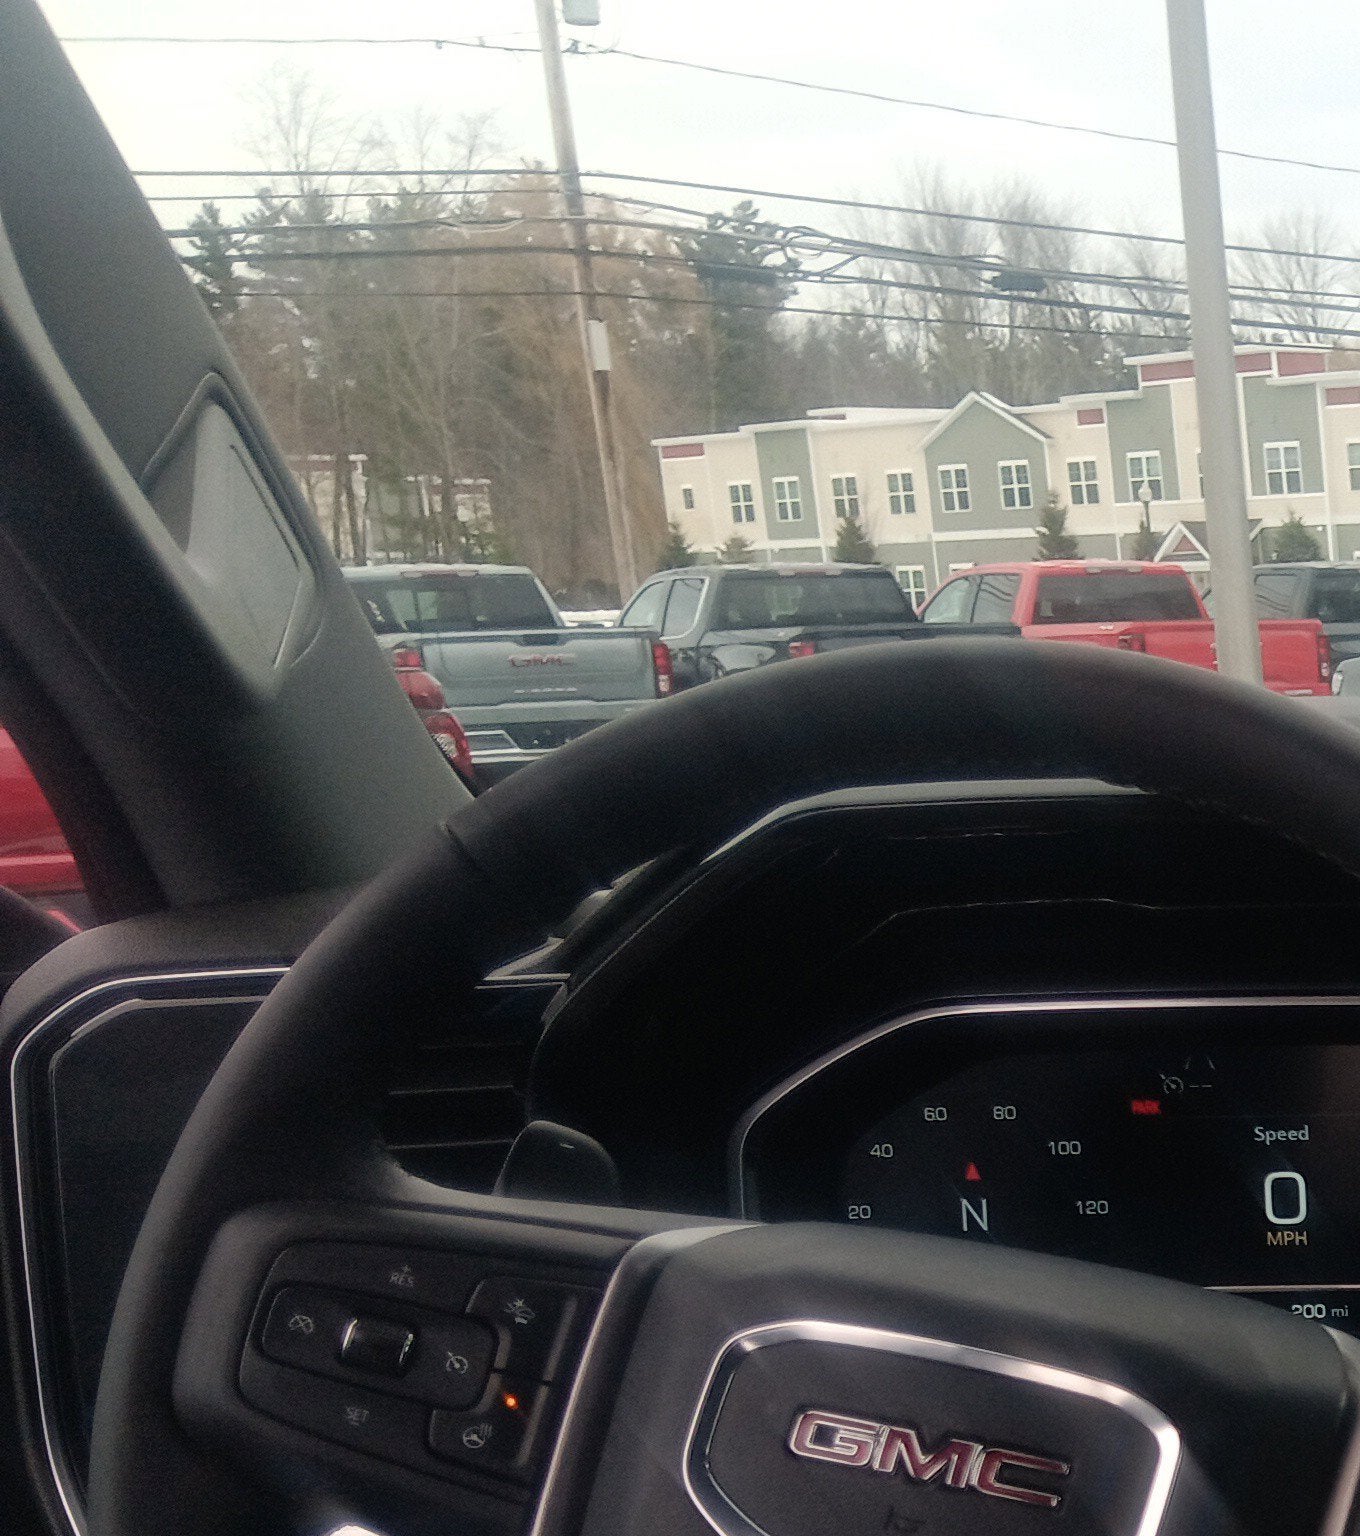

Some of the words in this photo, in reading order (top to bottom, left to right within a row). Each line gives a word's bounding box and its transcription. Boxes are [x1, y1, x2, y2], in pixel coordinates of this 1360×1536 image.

[924, 1106, 948, 1122] 60
[992, 1105, 1017, 1120] 80
[1253, 1125, 1310, 1144] Speed
[869, 1142, 894, 1159] 40
[1047, 1140, 1082, 1156] 100
[1263, 1171, 1309, 1225] 0
[847, 1204, 872, 1220] 20
[960, 1197, 990, 1233] N
[1076, 1200, 1109, 1216] 120
[1266, 1231, 1309, 1247] MPH
[1331, 1304, 1350, 1318] mi
[788, 1409, 1072, 1508] GMC
